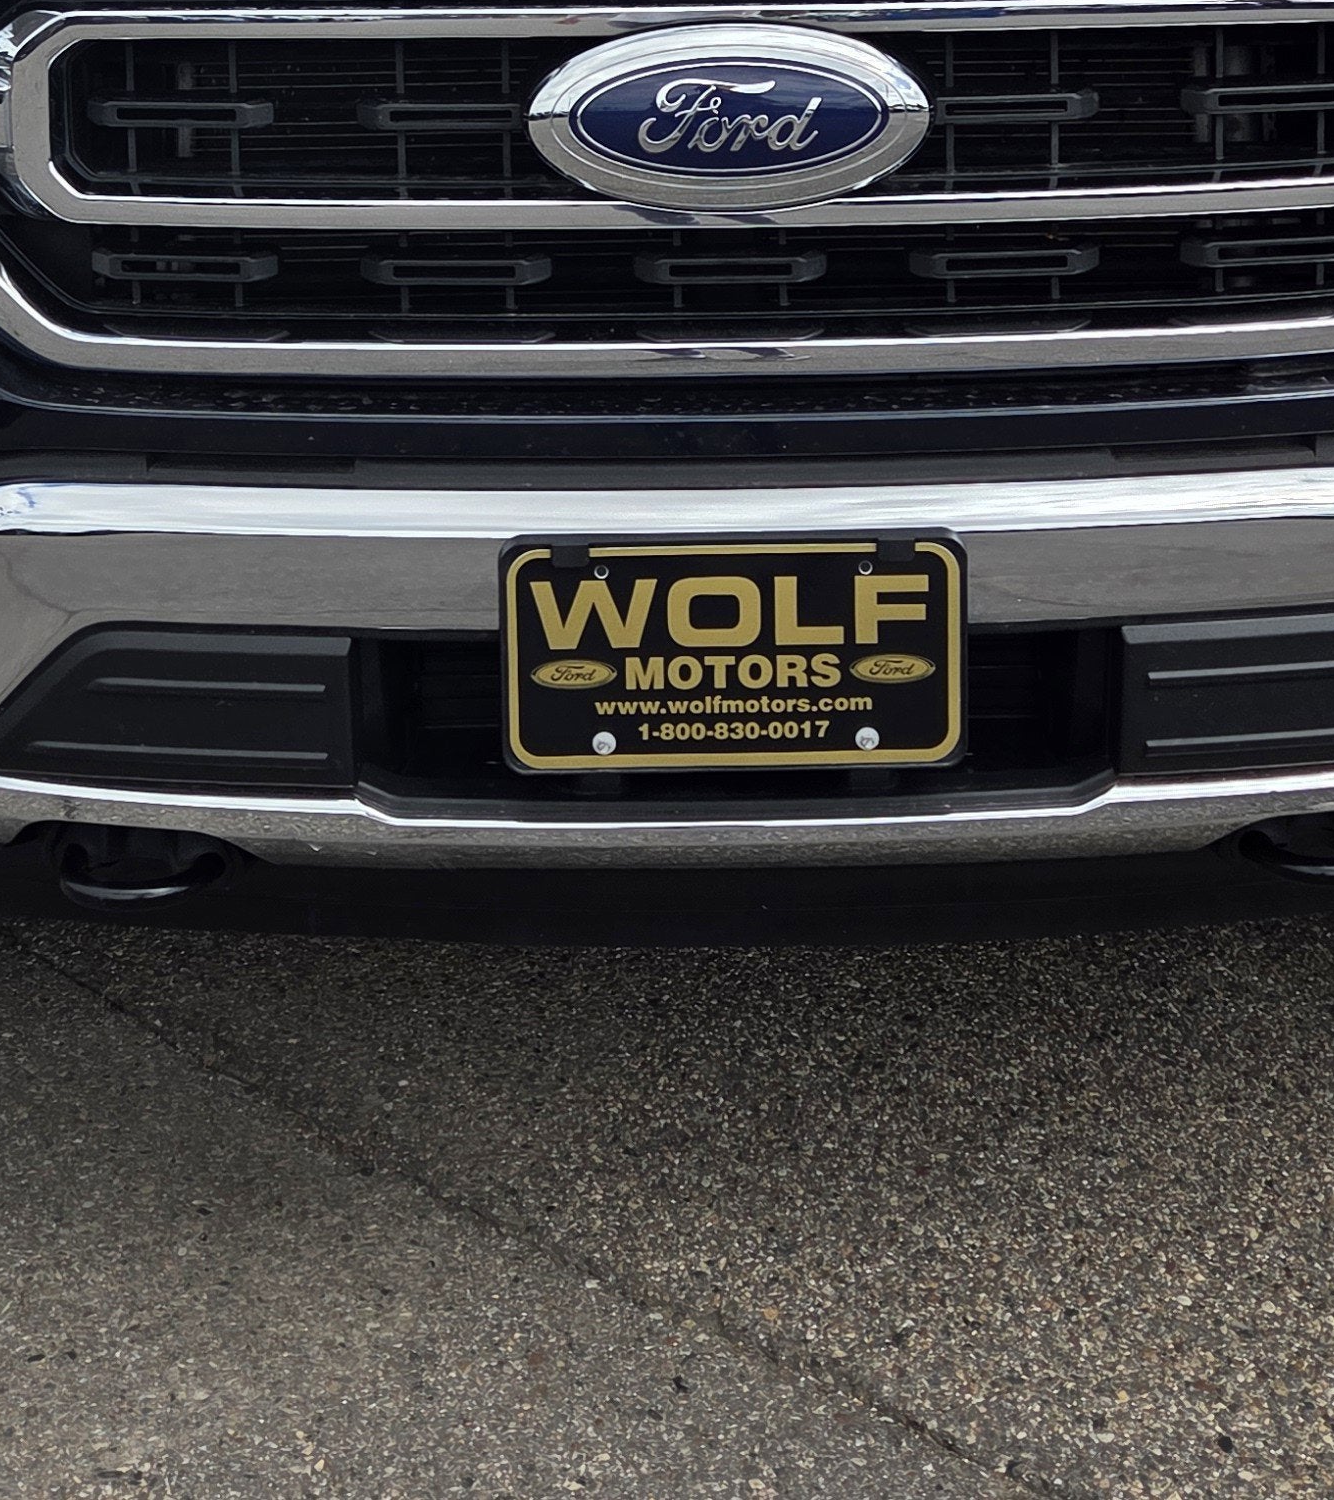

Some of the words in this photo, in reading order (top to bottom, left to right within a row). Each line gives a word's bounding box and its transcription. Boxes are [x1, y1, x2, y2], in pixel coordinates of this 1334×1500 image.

[637, 77, 822, 154] Ford
[529, 574, 930, 650] WOLF
[550, 665, 597, 682] Ford
[624, 652, 842, 690] MOTORS
[868, 658, 916, 677] Ford
[594, 695, 873, 716] www.wolfmotors.com
[638, 719, 831, 741] 1-800-830-0017
